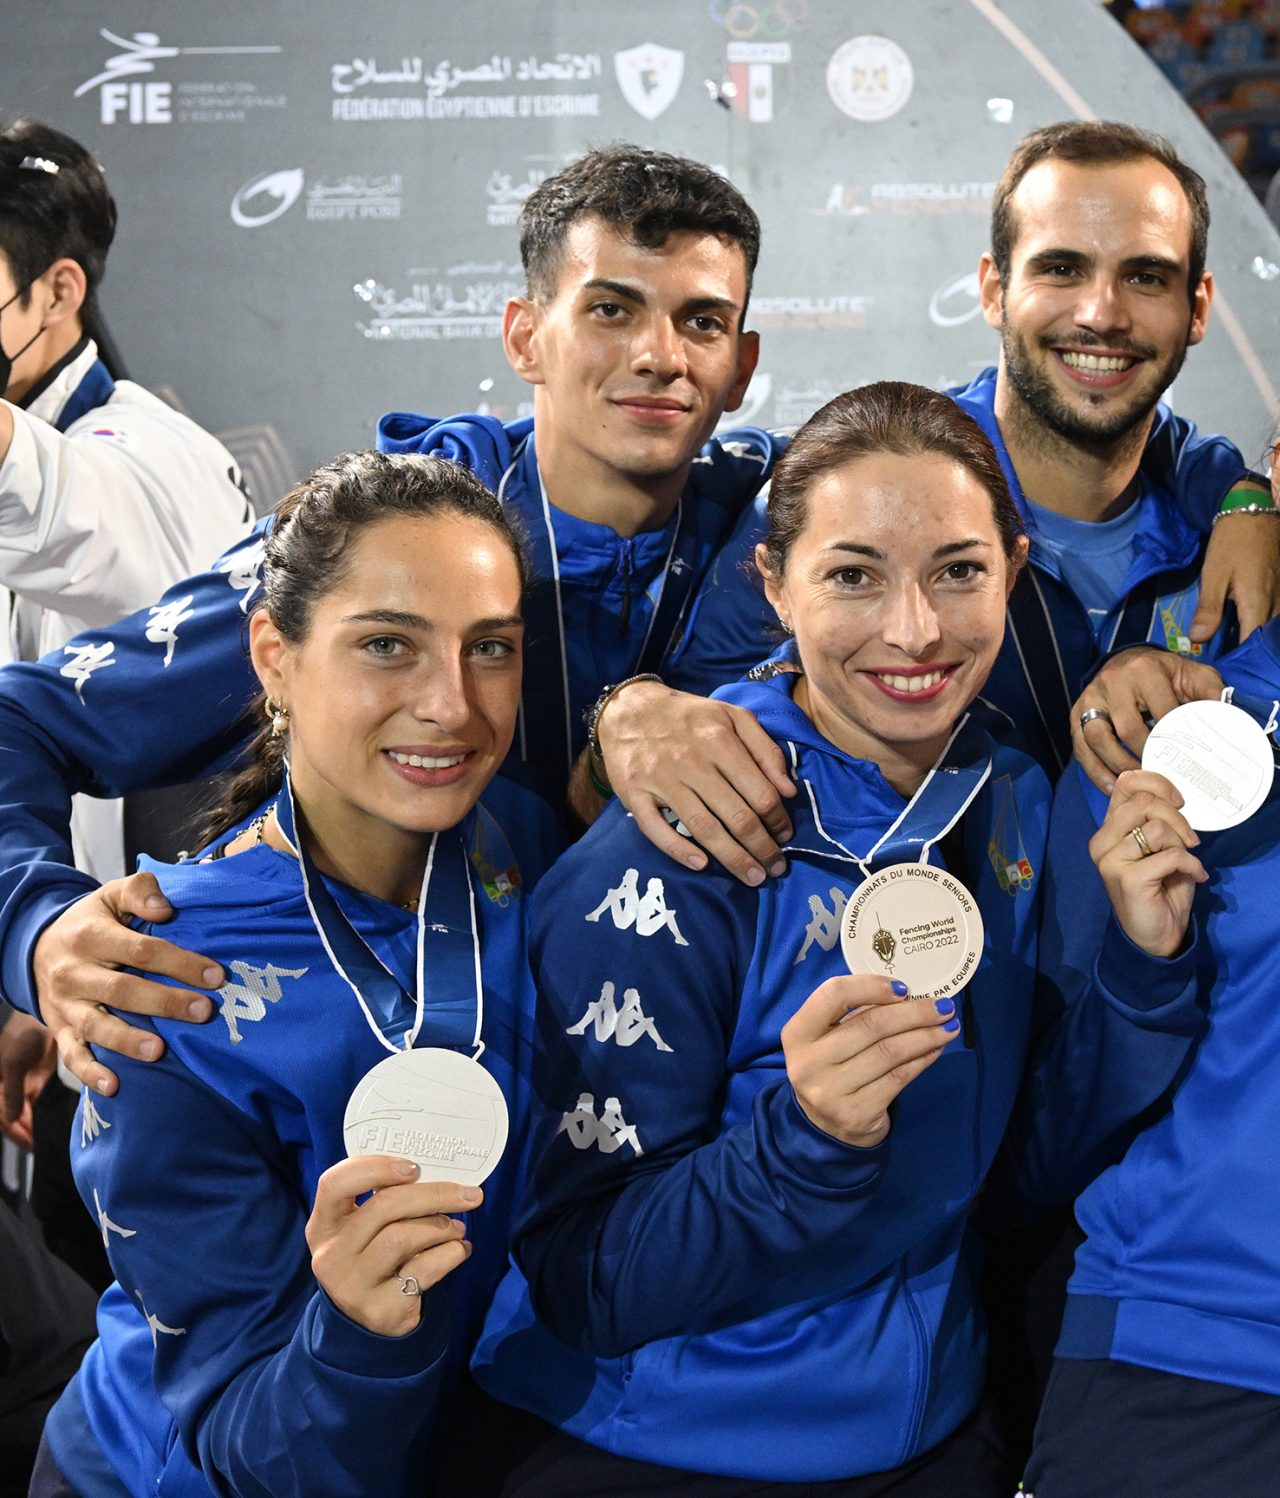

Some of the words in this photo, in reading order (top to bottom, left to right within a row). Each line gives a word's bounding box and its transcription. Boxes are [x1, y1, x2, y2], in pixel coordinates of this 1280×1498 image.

[101, 82, 172, 124] FIE
[848, 876, 888, 939] CHAMPIONNATS
[890, 869, 903, 880] DU
[907, 868, 940, 882] MONDE
[942, 879, 972, 913] SENIORS
[899, 922, 931, 936] Fencing
[931, 917, 955, 928] World
[901, 926, 957, 944] Championships
[903, 941, 934, 955] CAIRO
[935, 934, 960, 948] 2022
[934, 984, 951, 997] PAR
[952, 951, 976, 986] EQUIPES
[359, 1124, 405, 1154] FIE
